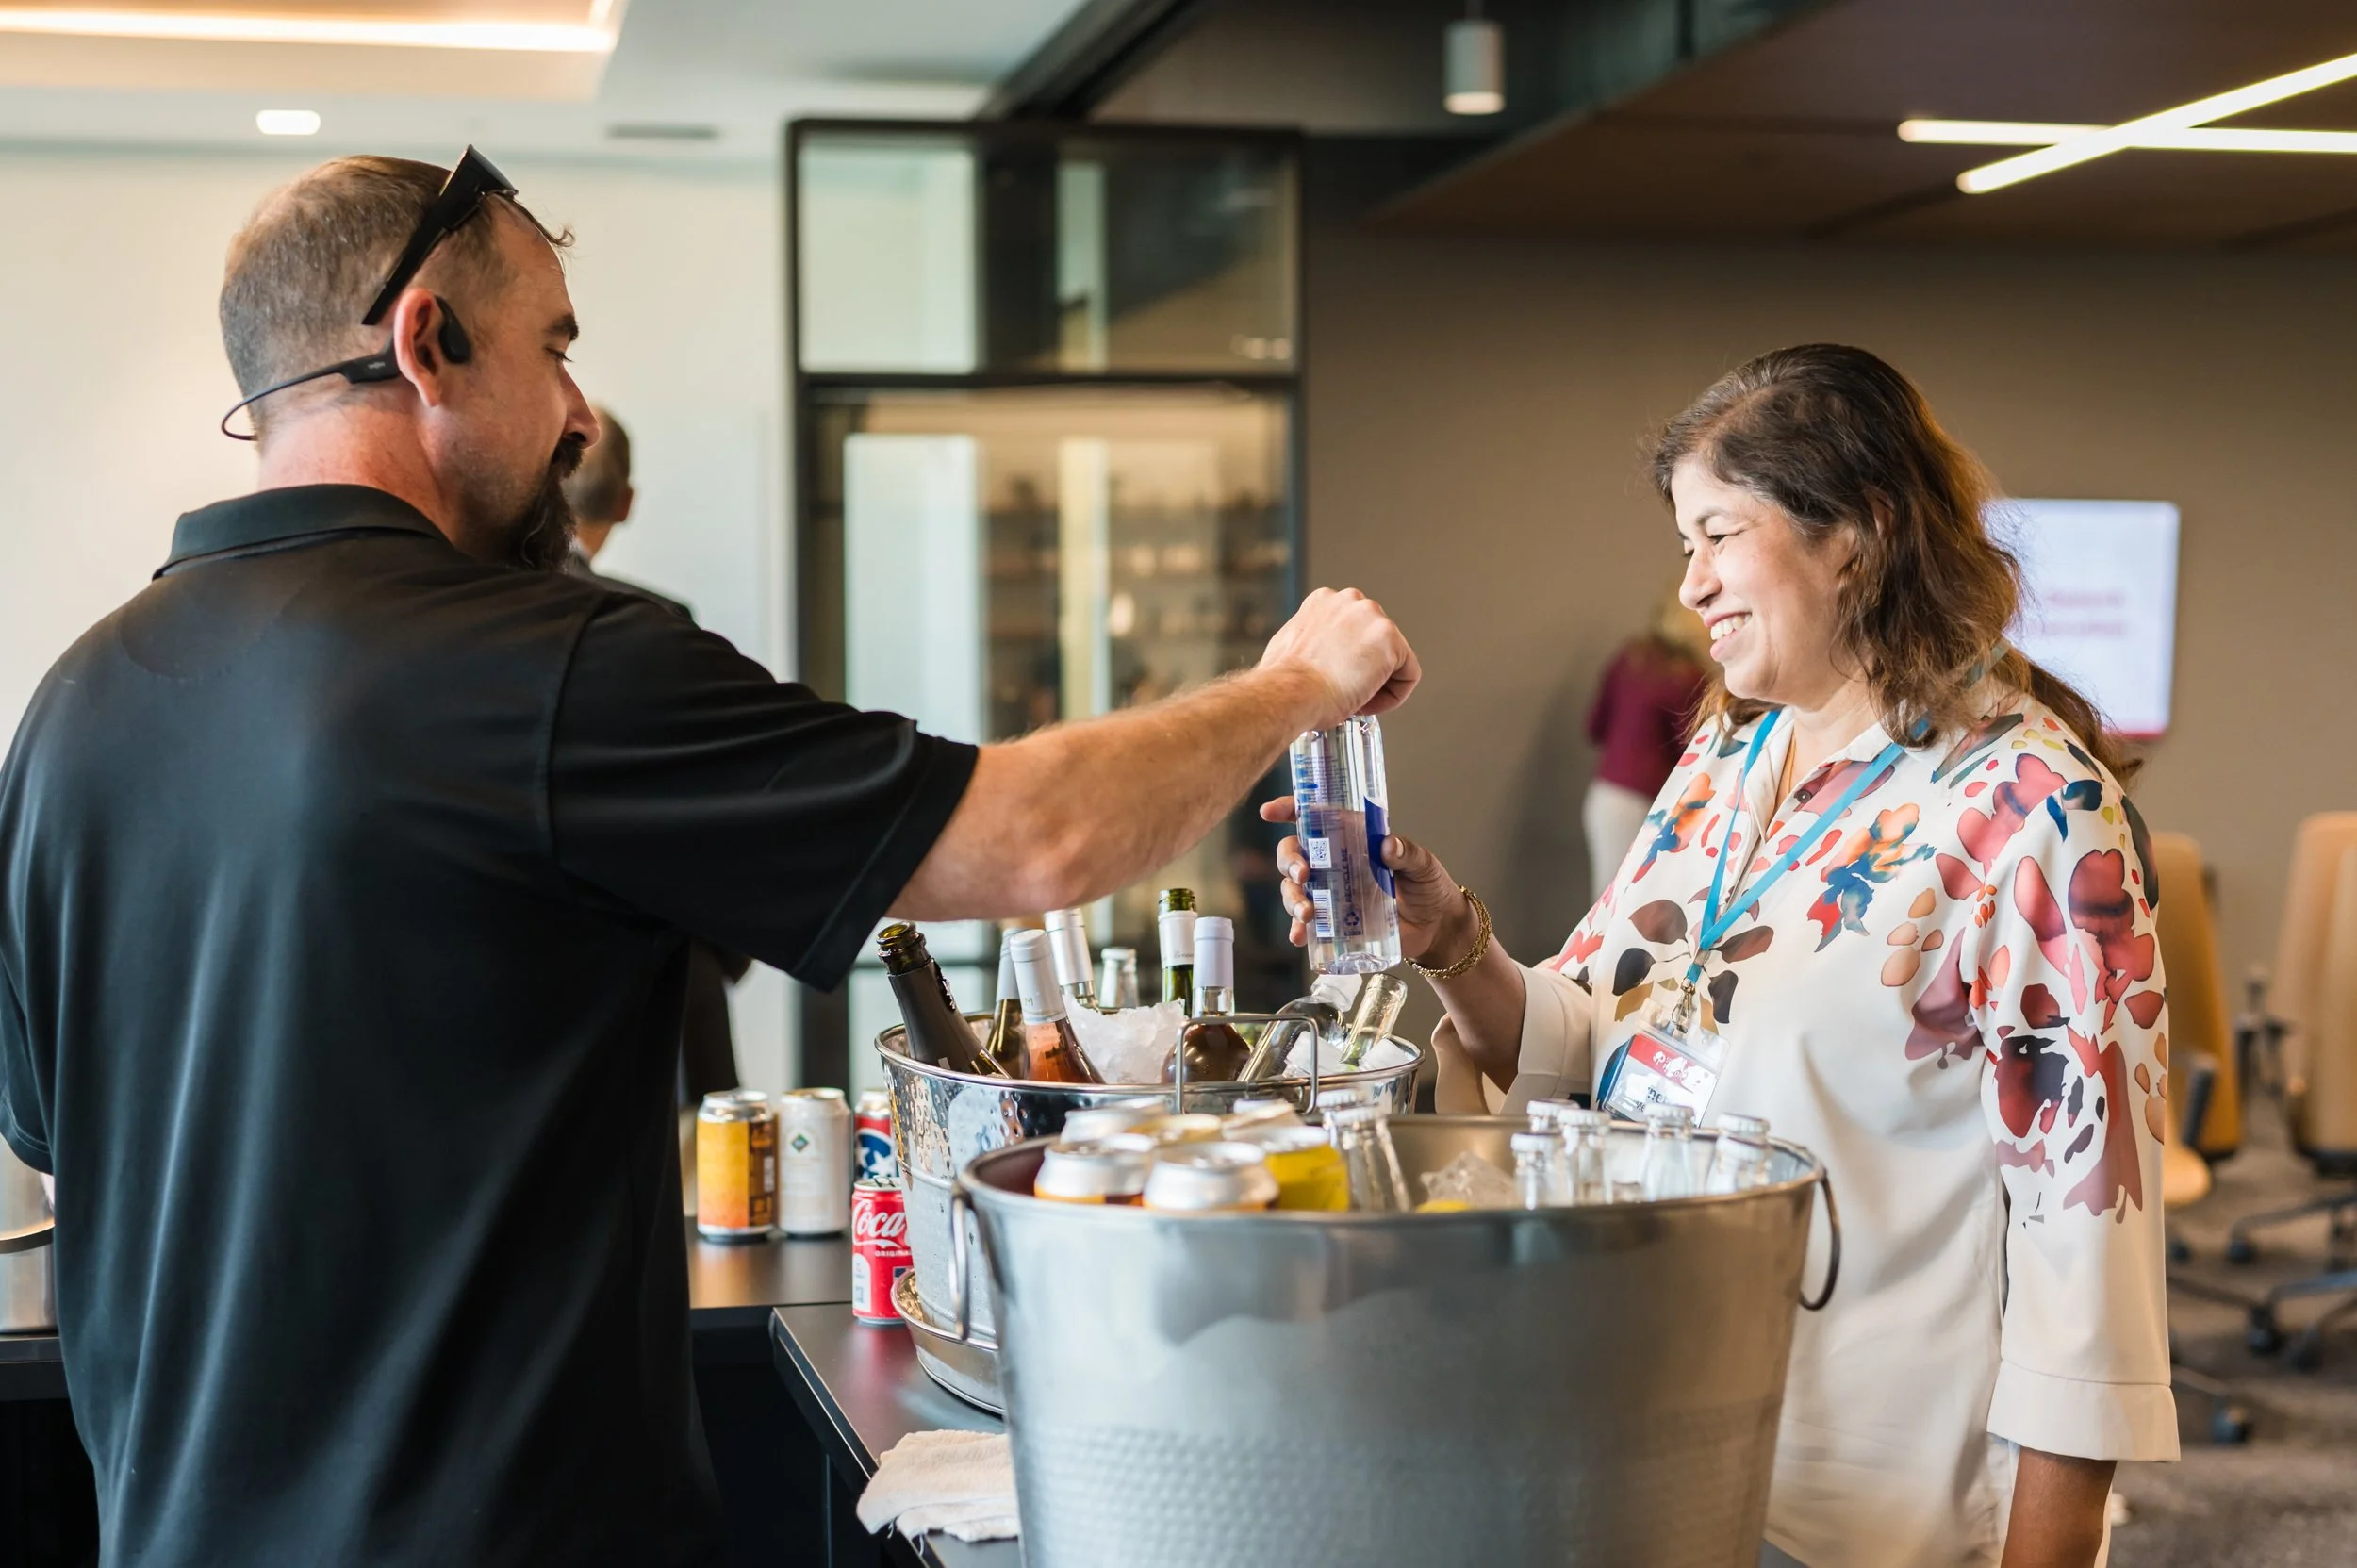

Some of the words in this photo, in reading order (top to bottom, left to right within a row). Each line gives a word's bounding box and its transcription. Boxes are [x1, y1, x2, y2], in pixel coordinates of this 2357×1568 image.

[1341, 847, 1348, 862] ME
[1342, 864, 1352, 903] RECYCLE
[852, 1198, 907, 1249] Coca
